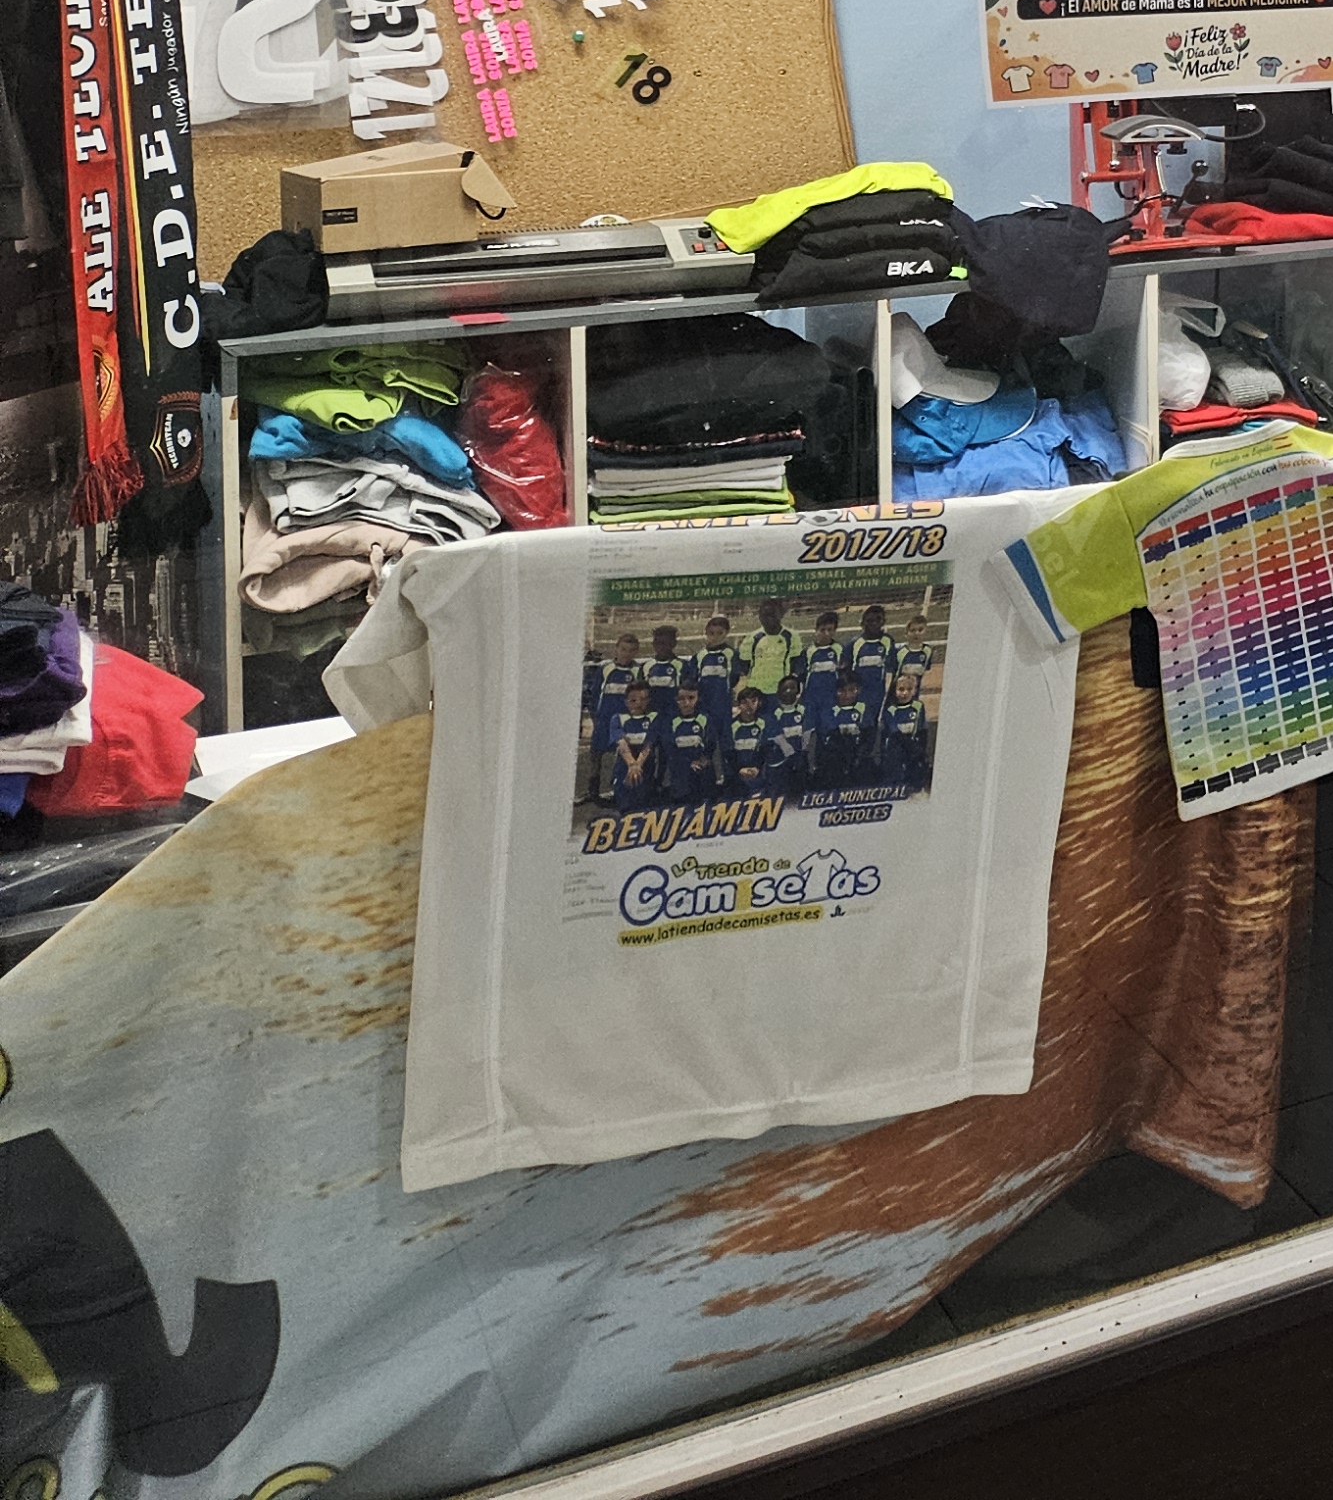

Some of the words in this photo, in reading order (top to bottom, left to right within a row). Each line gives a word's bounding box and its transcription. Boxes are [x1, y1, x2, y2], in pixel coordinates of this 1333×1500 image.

[161, 11, 178, 73] jugador
[477, 7, 509, 62] LAURA
[1184, 25, 1229, 48] ¡Feliz
[1185, 47, 1206, 60] Día
[1206, 45, 1220, 56] de
[1222, 43, 1233, 54] la
[460, 28, 487, 86] LAURA
[1182, 52, 1241, 80] Madre!
[167, 77, 190, 135] Ningún
[476, 87, 502, 143] LAURA
[493, 87, 518, 139] SONIA
[79, 188, 114, 314] ALE
[887, 259, 934, 277] BKA
[798, 526, 947, 564] 2017/18
[801, 791, 835, 808] LIGA
[837, 786, 908, 805] MUNICIPAL
[820, 804, 892, 826] MÓSTOLES
[583, 795, 784, 855] BENJAMÍN
[671, 856, 699, 879] La
[696, 856, 771, 880] Tienda
[773, 858, 792, 872] de
[619, 906, 823, 947] www.latiendadecamisetas.es
